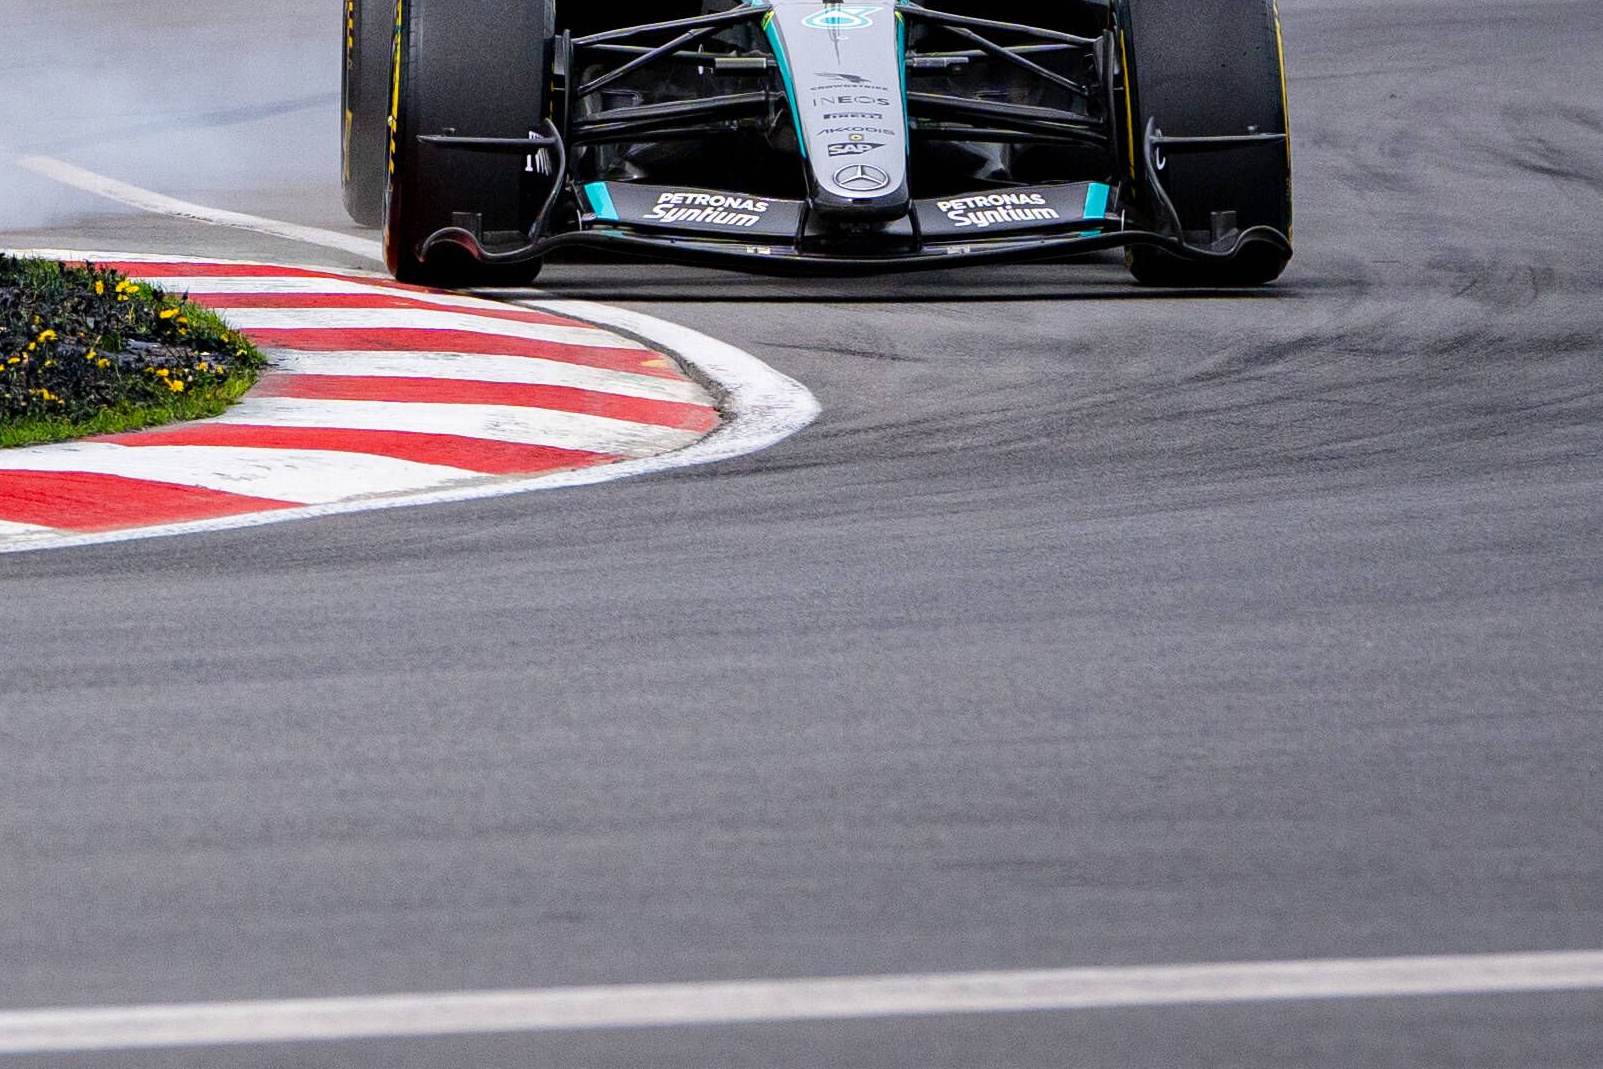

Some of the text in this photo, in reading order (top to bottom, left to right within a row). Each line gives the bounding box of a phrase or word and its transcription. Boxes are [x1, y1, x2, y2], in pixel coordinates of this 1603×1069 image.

[813, 95, 891, 107] INEOS
[828, 143, 873, 154] SAP
[657, 193, 769, 212] PETRONAS
[937, 193, 1046, 212] PETRONAS
[643, 203, 760, 227] Syntium
[947, 205, 1060, 227] Syntium
